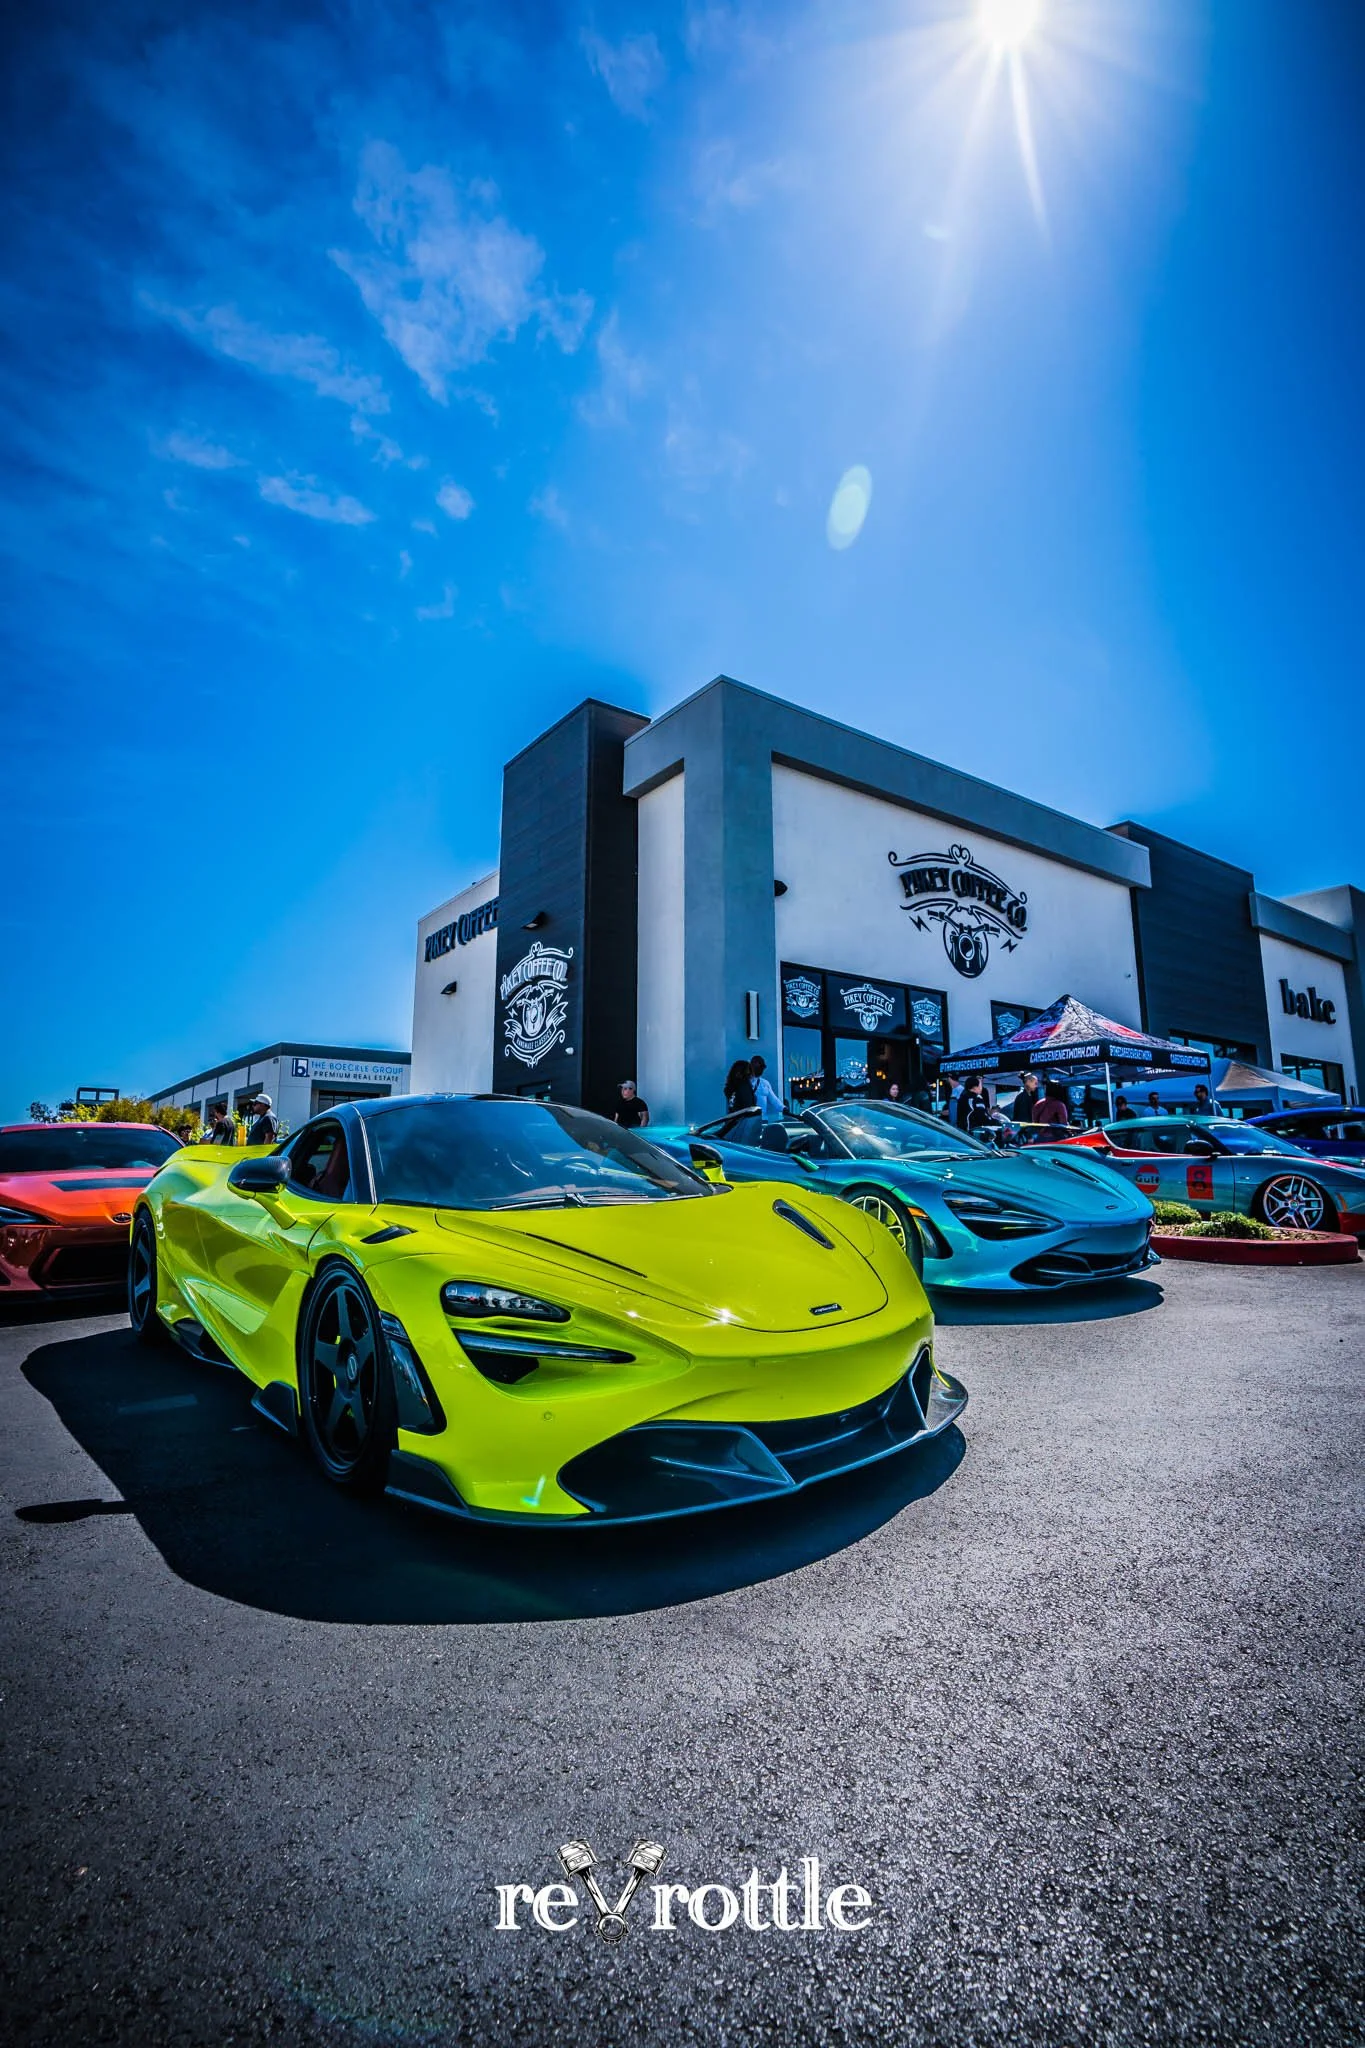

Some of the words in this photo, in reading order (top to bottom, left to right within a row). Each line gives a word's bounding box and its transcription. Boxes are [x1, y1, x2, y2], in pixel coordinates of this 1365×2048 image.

[900, 867, 950, 898] PIKEY
[951, 870, 1007, 914] COFFEE
[424, 922, 457, 962] PIKEY
[500, 965, 524, 1000] PIKEY
[523, 957, 555, 981] COFFEE
[844, 993, 862, 1006] PIKEY
[862, 993, 884, 1008] COFFEE
[1278, 978, 1337, 1025] bake
[311, 1061, 327, 1069] THE
[329, 1061, 369, 1073] BOECKLE
[372, 1065, 404, 1075] GROUP
[313, 1070, 351, 1079] PREMIUM
[1135, 1174, 1160, 1184] Gulf
[1192, 1170, 1208, 1193] 8
